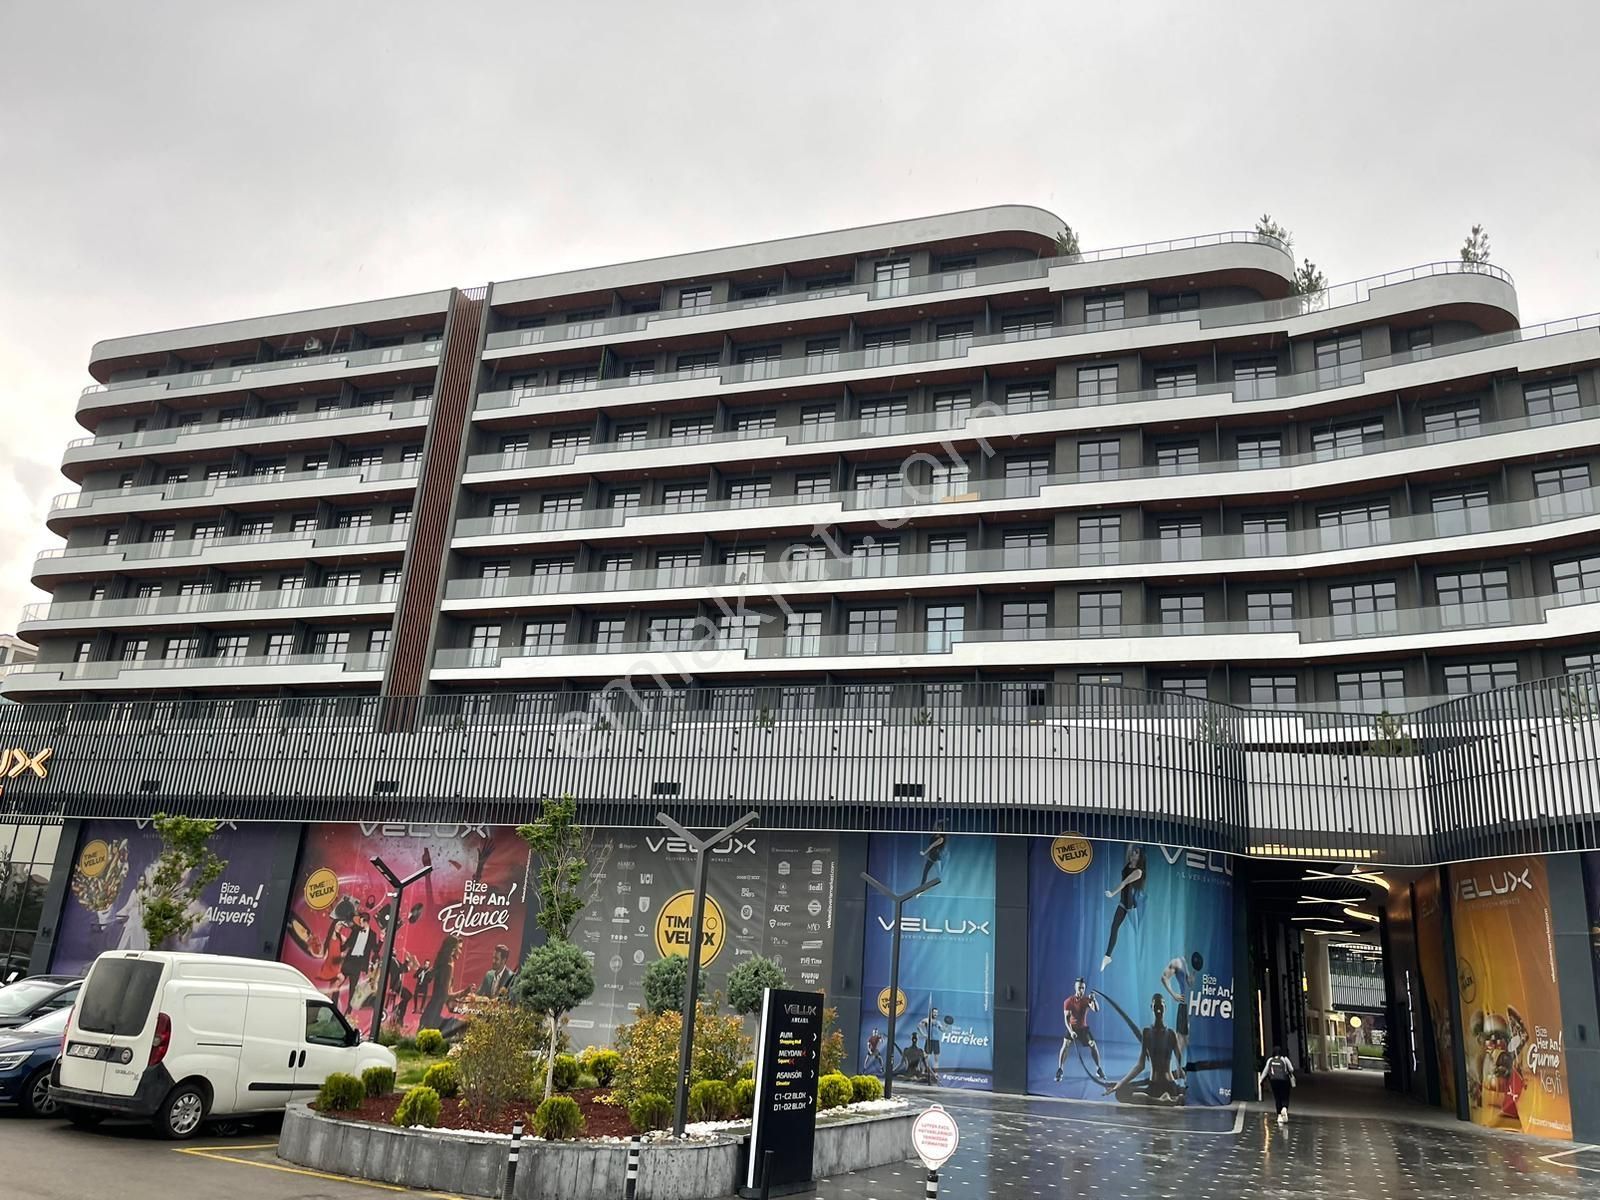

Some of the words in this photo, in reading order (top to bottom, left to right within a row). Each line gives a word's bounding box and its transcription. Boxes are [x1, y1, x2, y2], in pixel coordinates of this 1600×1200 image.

[1057, 849, 1088, 862] VELUX
[220, 882, 240, 894] Bize
[309, 885, 335, 899] VELUX
[464, 880, 488, 893] Bize
[218, 893, 239, 905] Her
[463, 892, 487, 905] Her
[773, 904, 790, 913] KFC
[438, 903, 510, 937] Eğlence
[877, 916, 989, 935] VELUX
[664, 930, 716, 946] VELX
[1202, 974, 1217, 985] Bize
[1202, 985, 1216, 996] Her
[784, 1004, 817, 1016] VELUX
[941, 1032, 988, 1047] Hareket
[1537, 1037, 1549, 1050] Her
[1527, 1044, 1560, 1075] Gurme
[776, 1070, 802, 1079] ASANSÖR
[1540, 1069, 1563, 1099] Keyfi
